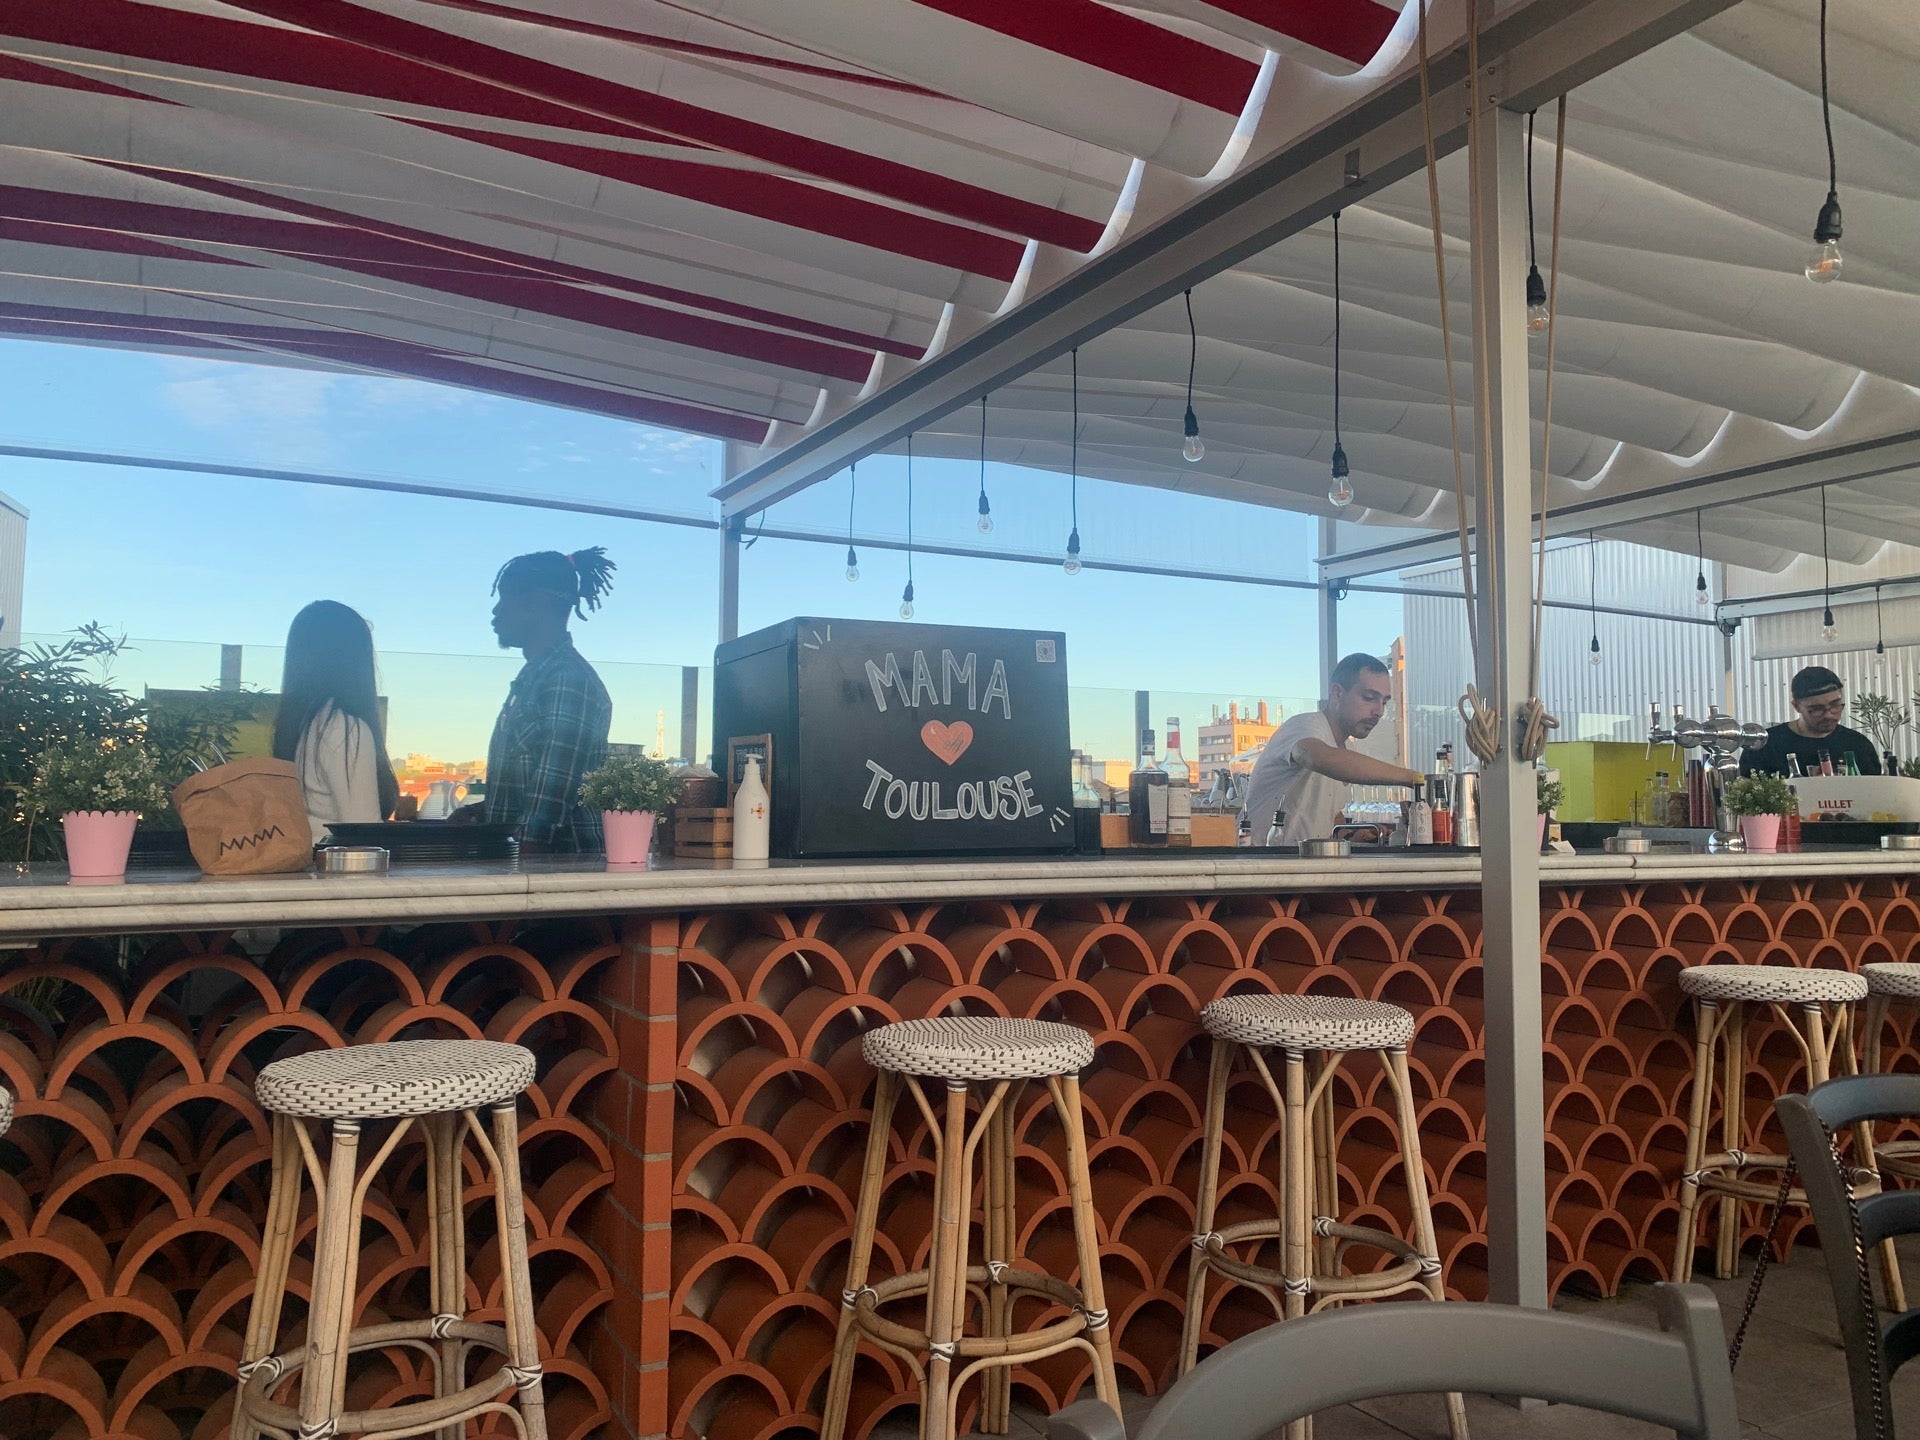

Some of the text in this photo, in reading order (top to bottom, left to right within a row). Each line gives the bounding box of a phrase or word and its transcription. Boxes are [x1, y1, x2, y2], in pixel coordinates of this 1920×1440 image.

[864, 649, 1011, 720] MAMA
[862, 759, 1044, 821] TOULOUSE
[1818, 799, 1853, 809] LILLET
